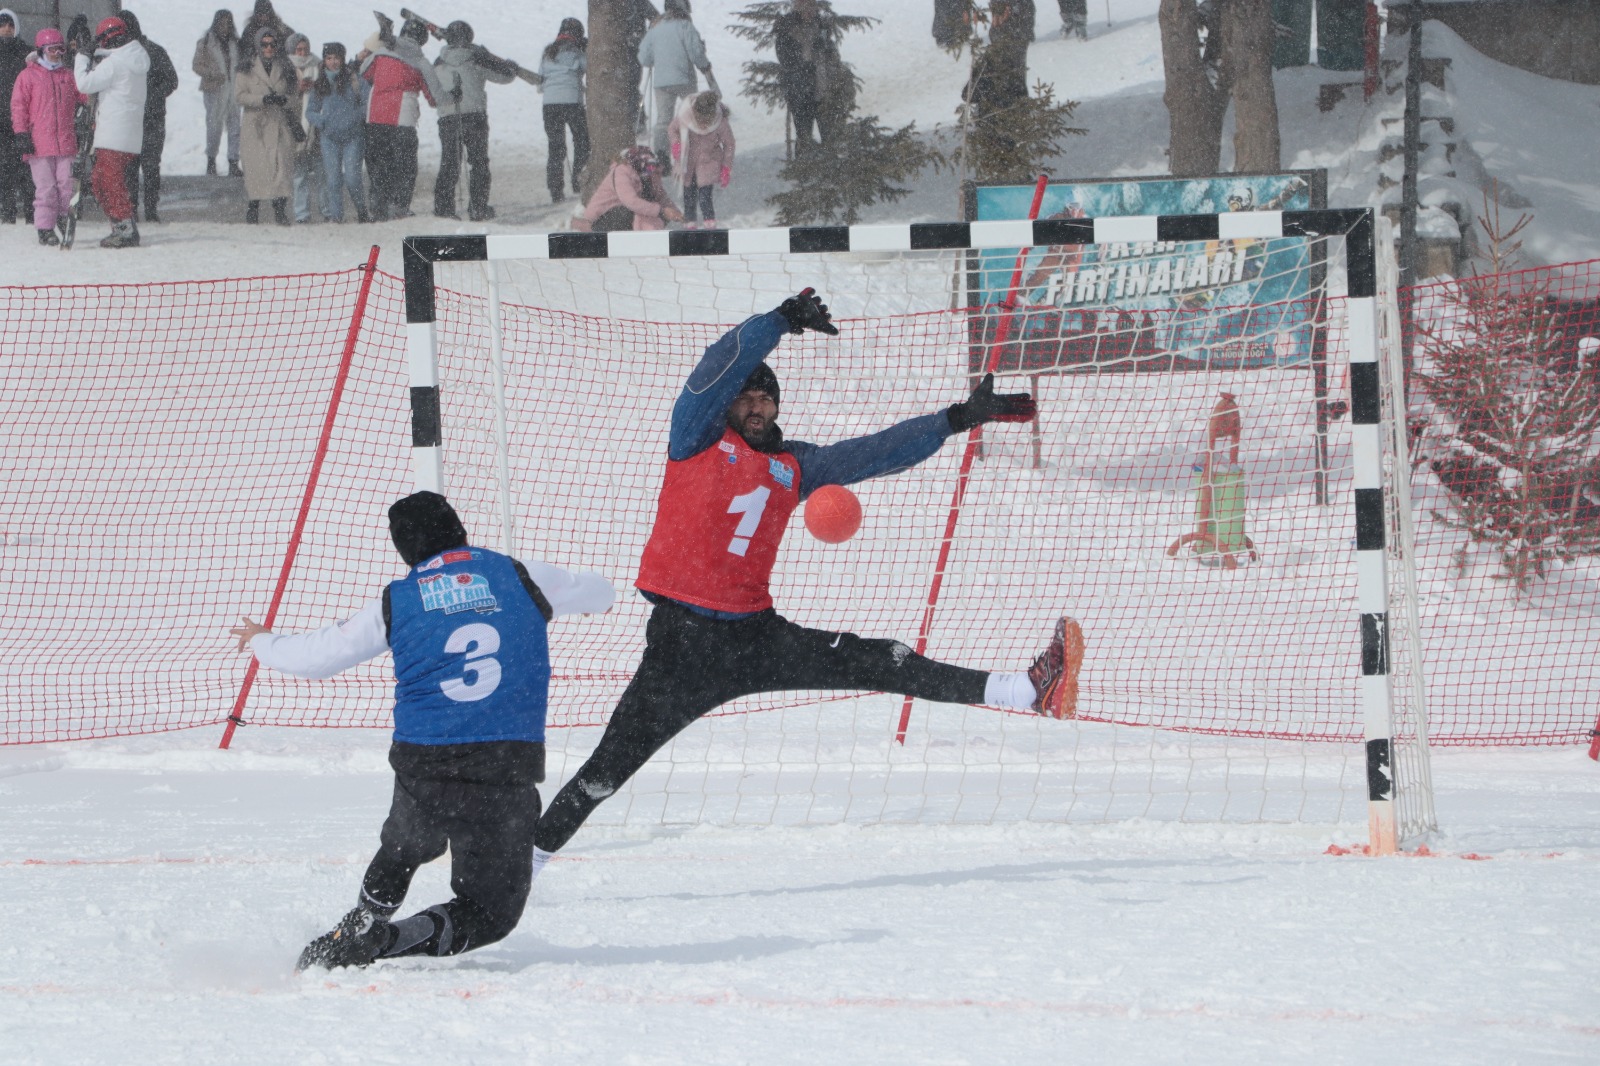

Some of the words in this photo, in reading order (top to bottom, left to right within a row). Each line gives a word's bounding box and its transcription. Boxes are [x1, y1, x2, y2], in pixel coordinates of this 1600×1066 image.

[1045, 249, 1247, 305] FIRTINALARI
[727, 485, 771, 557] 1
[439, 623, 502, 702] 3
